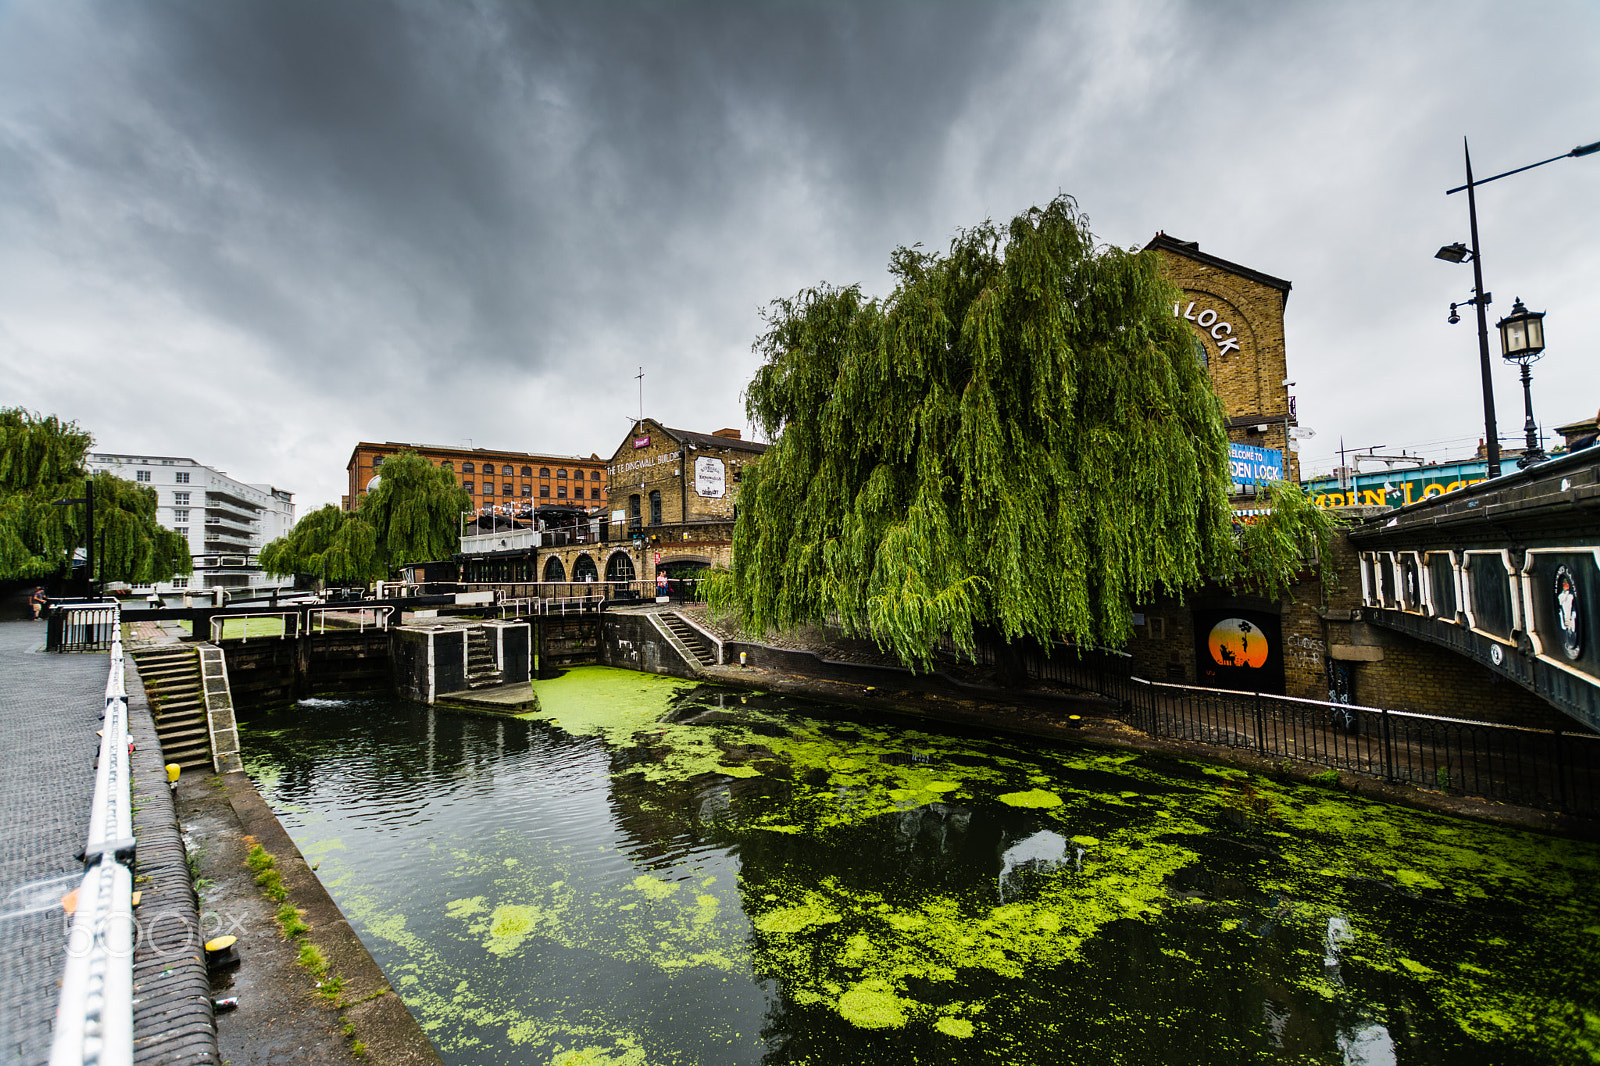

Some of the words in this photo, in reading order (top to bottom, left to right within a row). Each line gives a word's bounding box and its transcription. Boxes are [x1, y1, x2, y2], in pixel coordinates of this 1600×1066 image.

[1184, 301, 1240, 356] LOCK
[625, 456, 656, 471] DINGWALL
[1255, 452, 1263, 462] TO
[1229, 461, 1251, 478] DEN
[1254, 463, 1279, 480] LOCK
[1400, 478, 1488, 506] LOC
